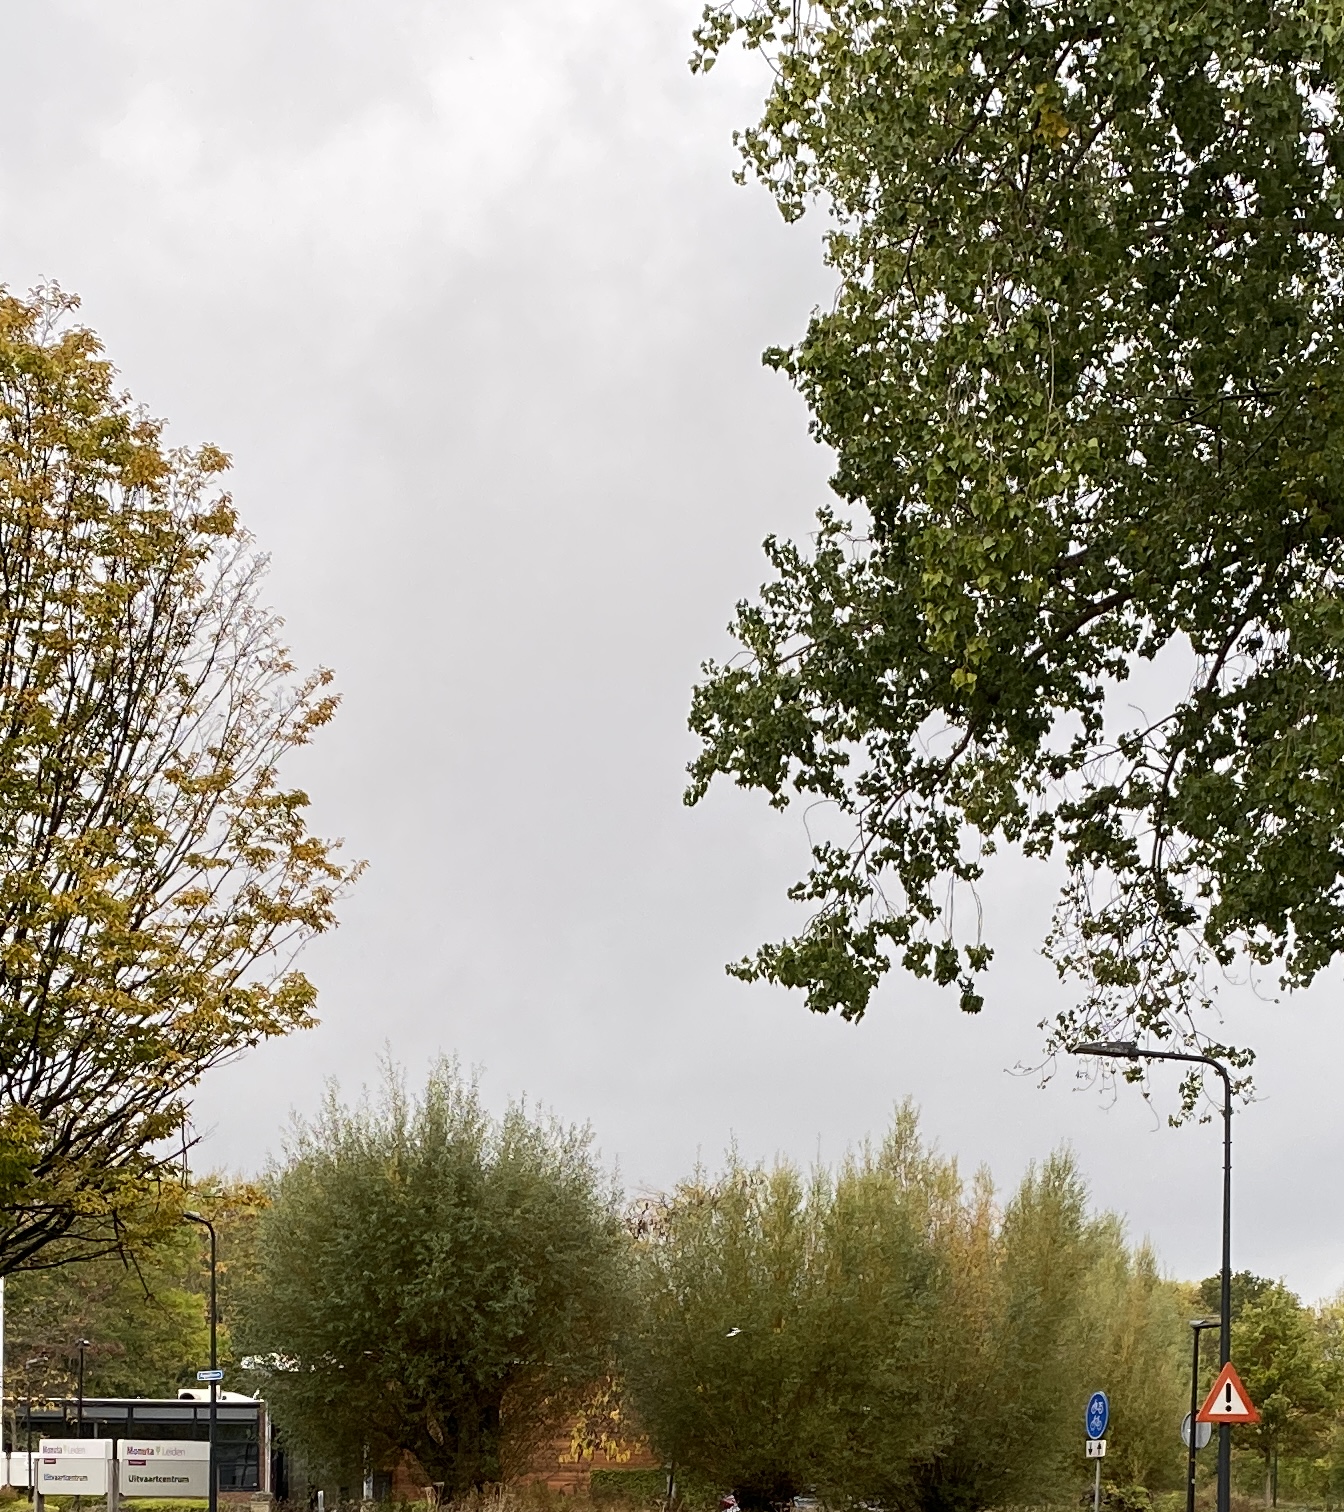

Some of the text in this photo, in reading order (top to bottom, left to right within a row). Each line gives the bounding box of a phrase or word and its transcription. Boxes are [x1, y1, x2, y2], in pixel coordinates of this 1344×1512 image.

[67, 1446, 86, 1455] Leiden
[127, 1446, 186, 1456] Monuta Leiden
[128, 1474, 190, 1483] Uitvaartcentrum
